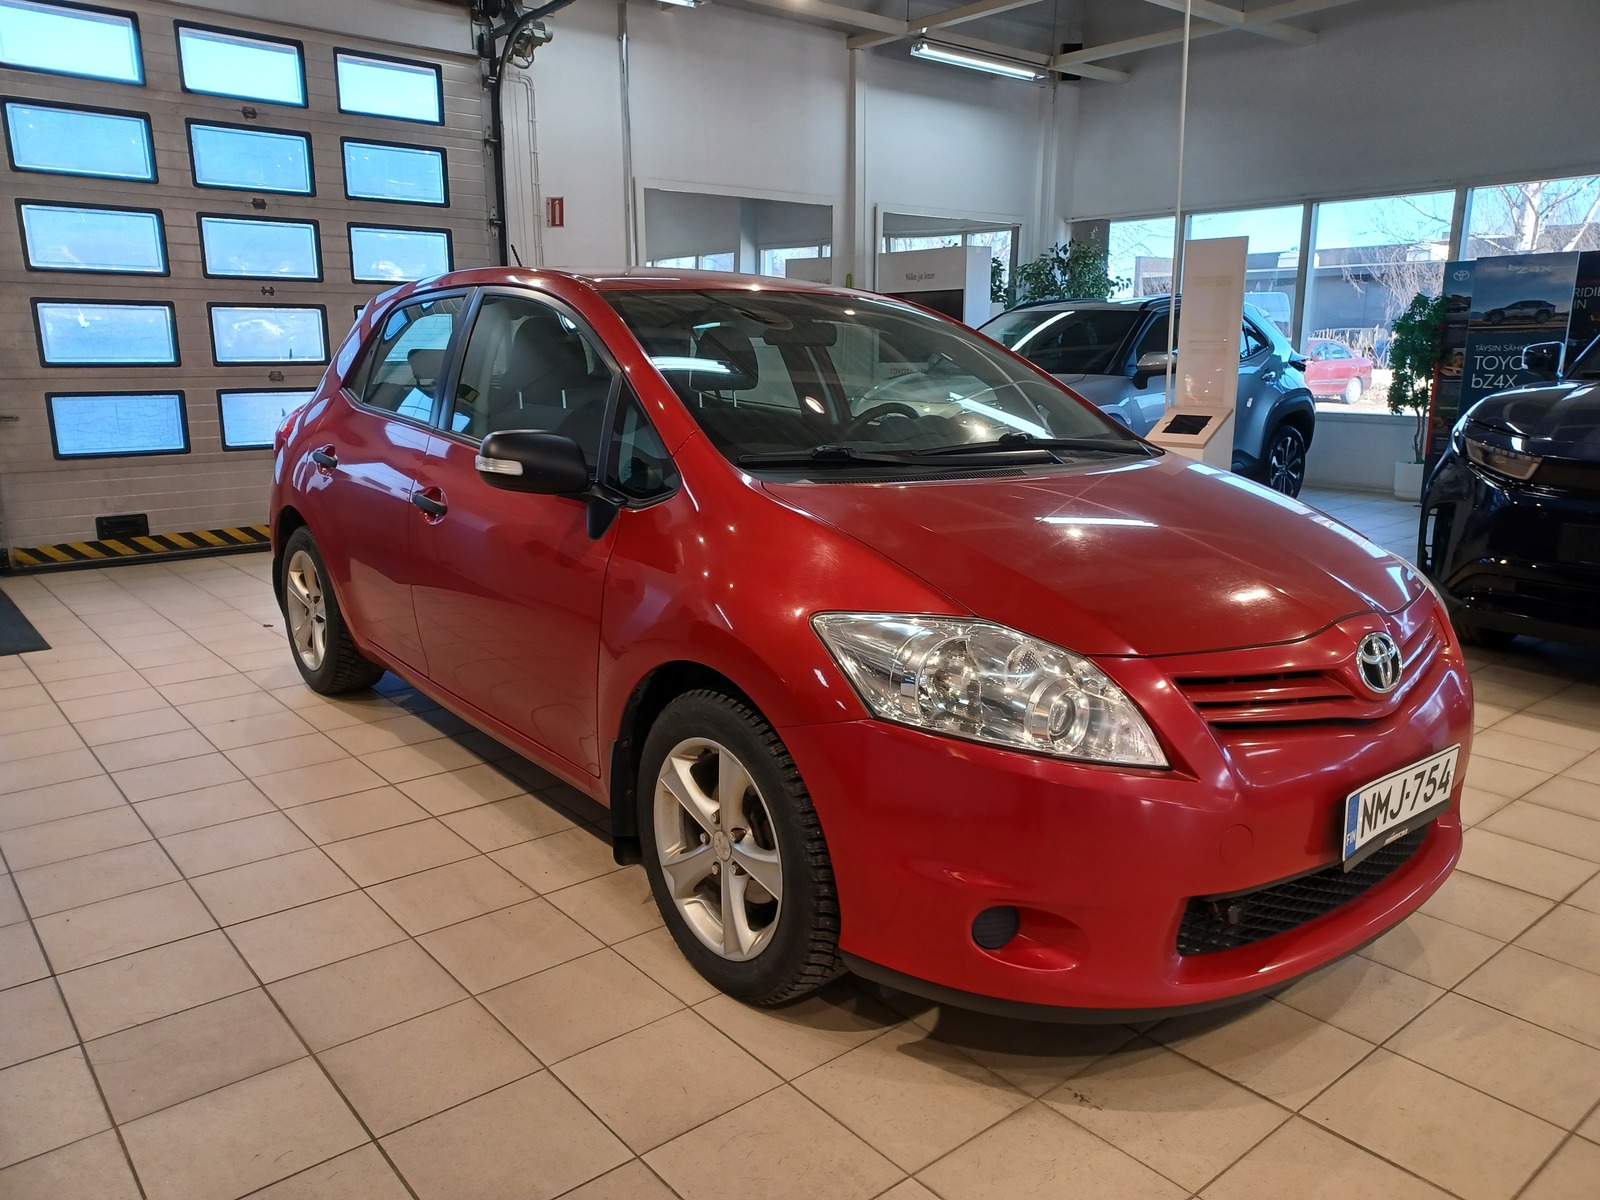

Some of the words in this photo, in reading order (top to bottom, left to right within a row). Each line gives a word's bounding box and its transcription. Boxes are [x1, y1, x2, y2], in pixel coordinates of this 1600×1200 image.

[905, 272, 917, 280] Näe
[923, 272, 935, 280] koe
[1475, 343, 1501, 352] TÄYSIN
[1471, 373, 1518, 389] bZ4X
[1361, 758, 1451, 839] NMJ-754
[1346, 829, 1357, 847] FIN
